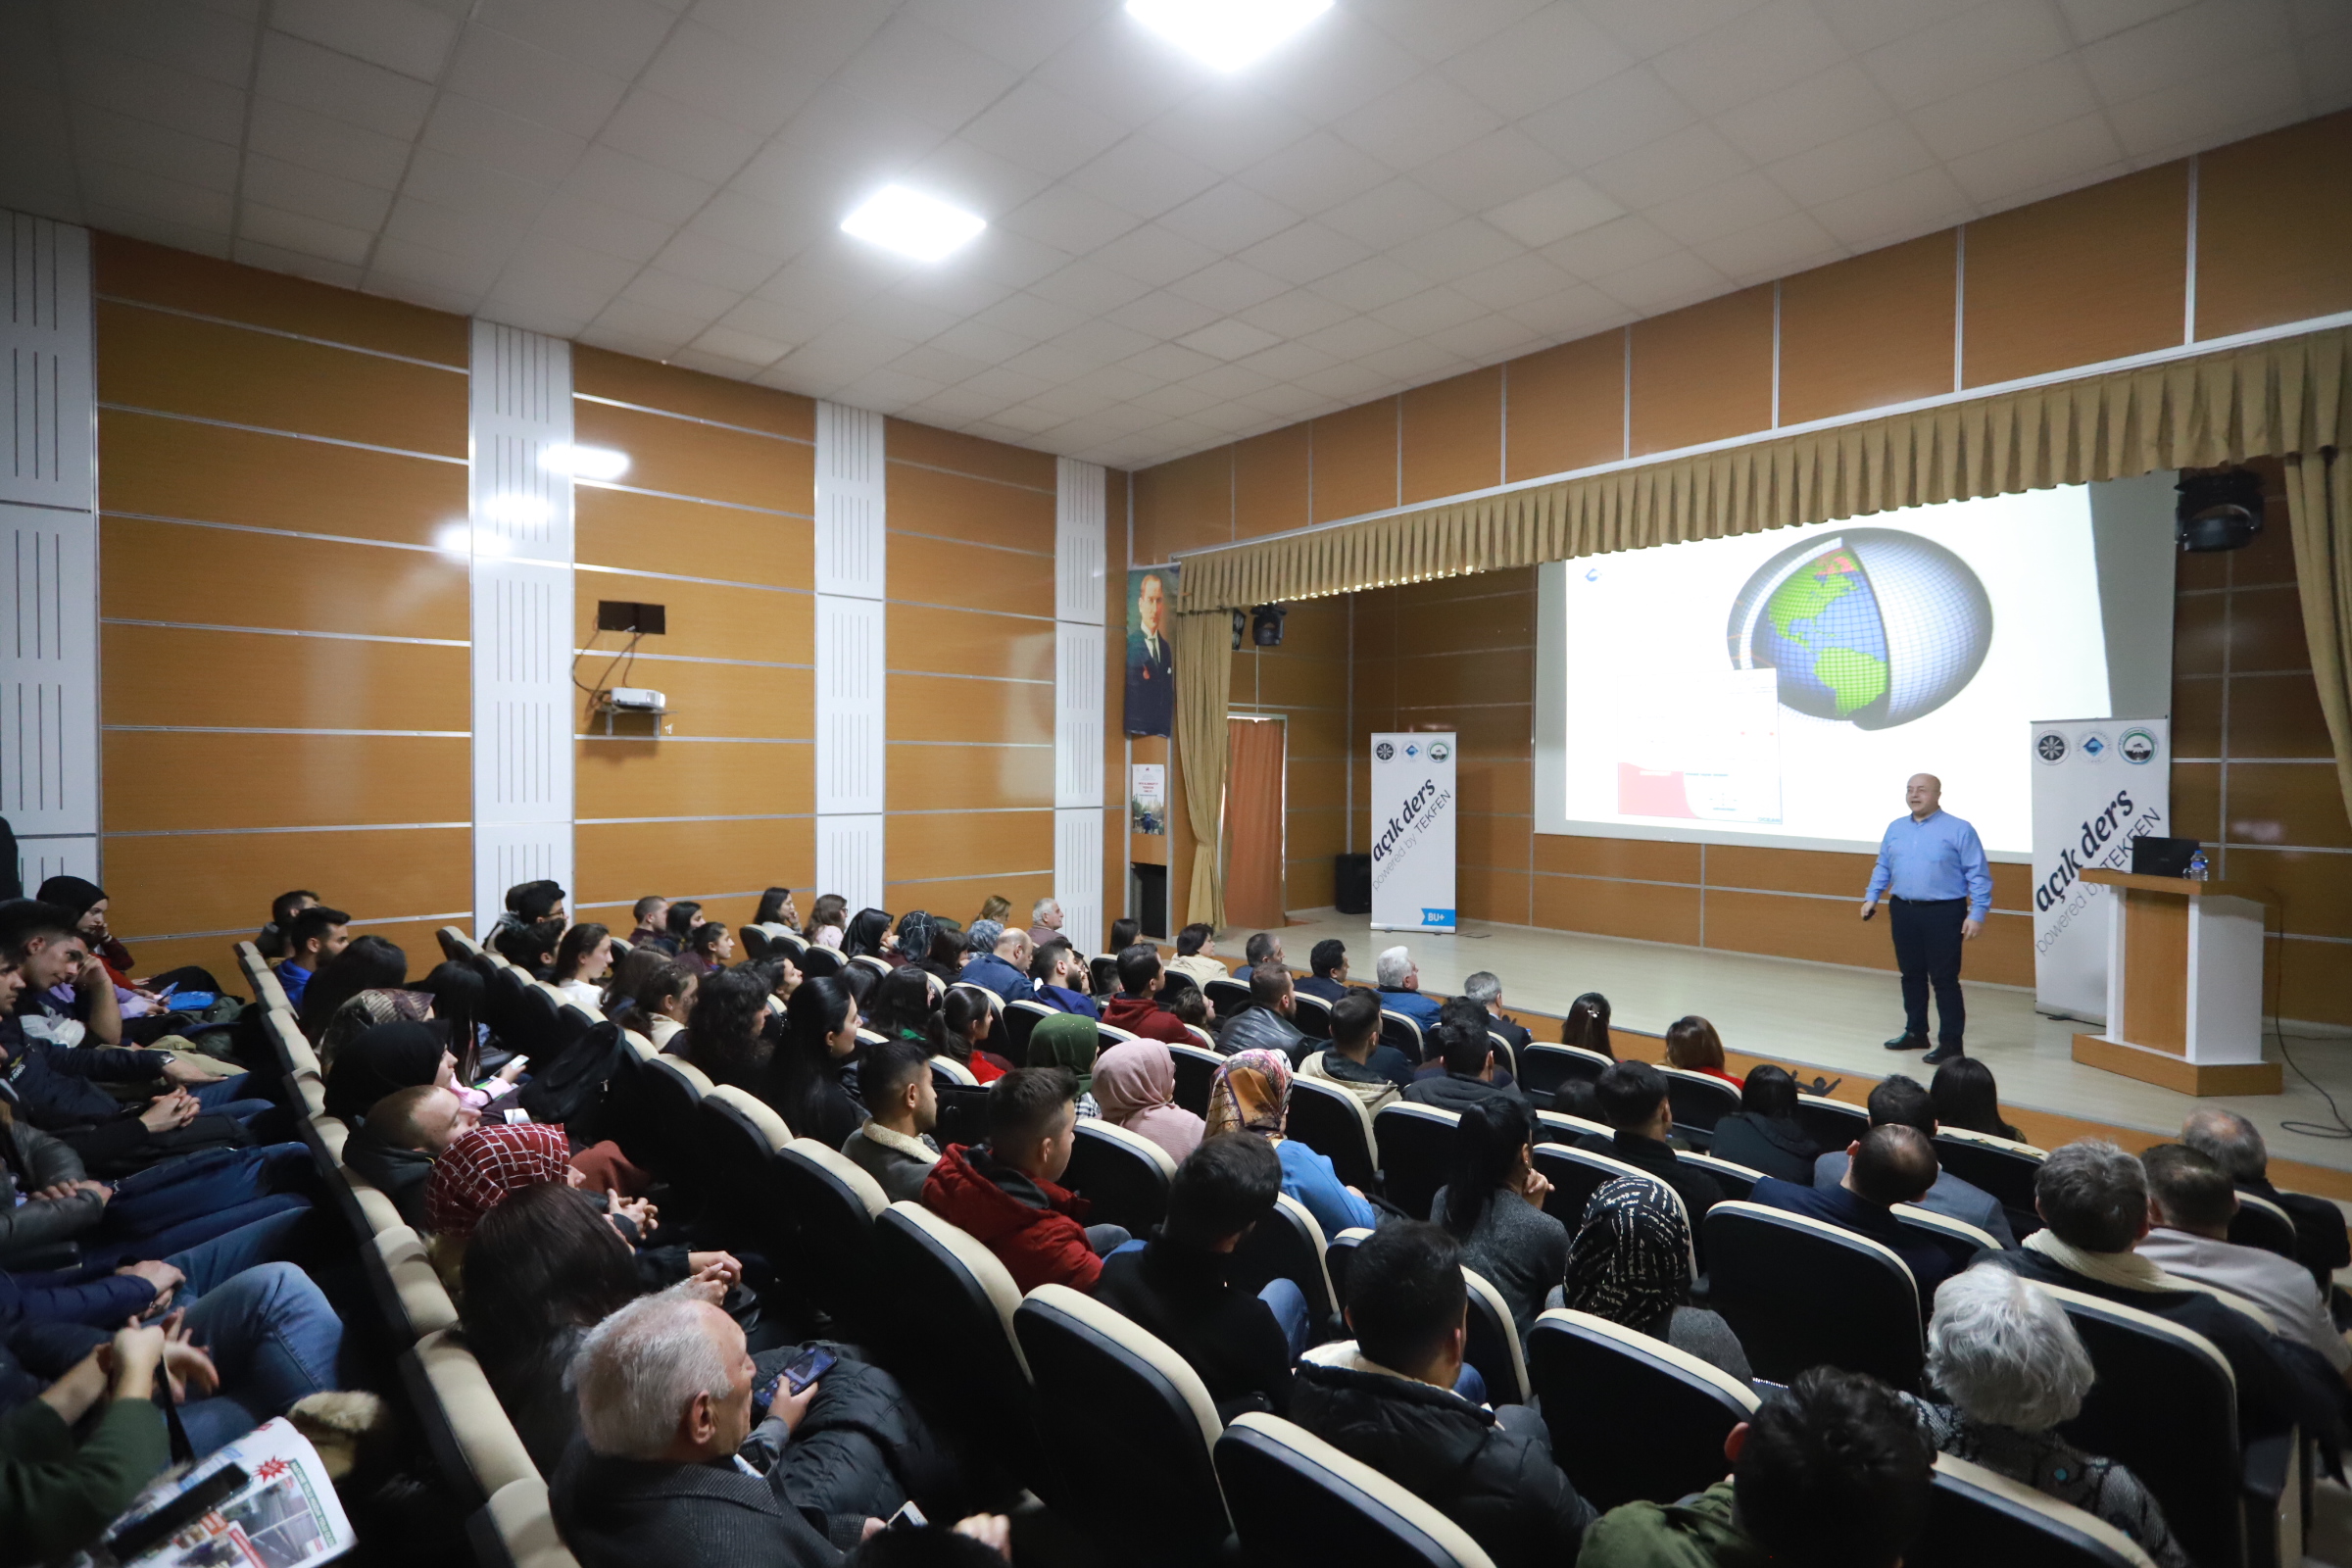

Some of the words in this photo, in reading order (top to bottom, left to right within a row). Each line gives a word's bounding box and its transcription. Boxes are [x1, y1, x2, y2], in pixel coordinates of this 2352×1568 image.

[1372, 817, 1404, 862] açık
[1403, 778, 1436, 824] ders
[1372, 847, 1405, 892] powered
[1403, 833, 1417, 850] by
[1414, 789, 1451, 834] TEKFEN
[2035, 848, 2083, 912] açık
[2081, 789, 2134, 859] ders
[1428, 912, 1446, 922] BU+
[2034, 893, 2087, 957] powered
[2099, 807, 2161, 869] TEKFEN
